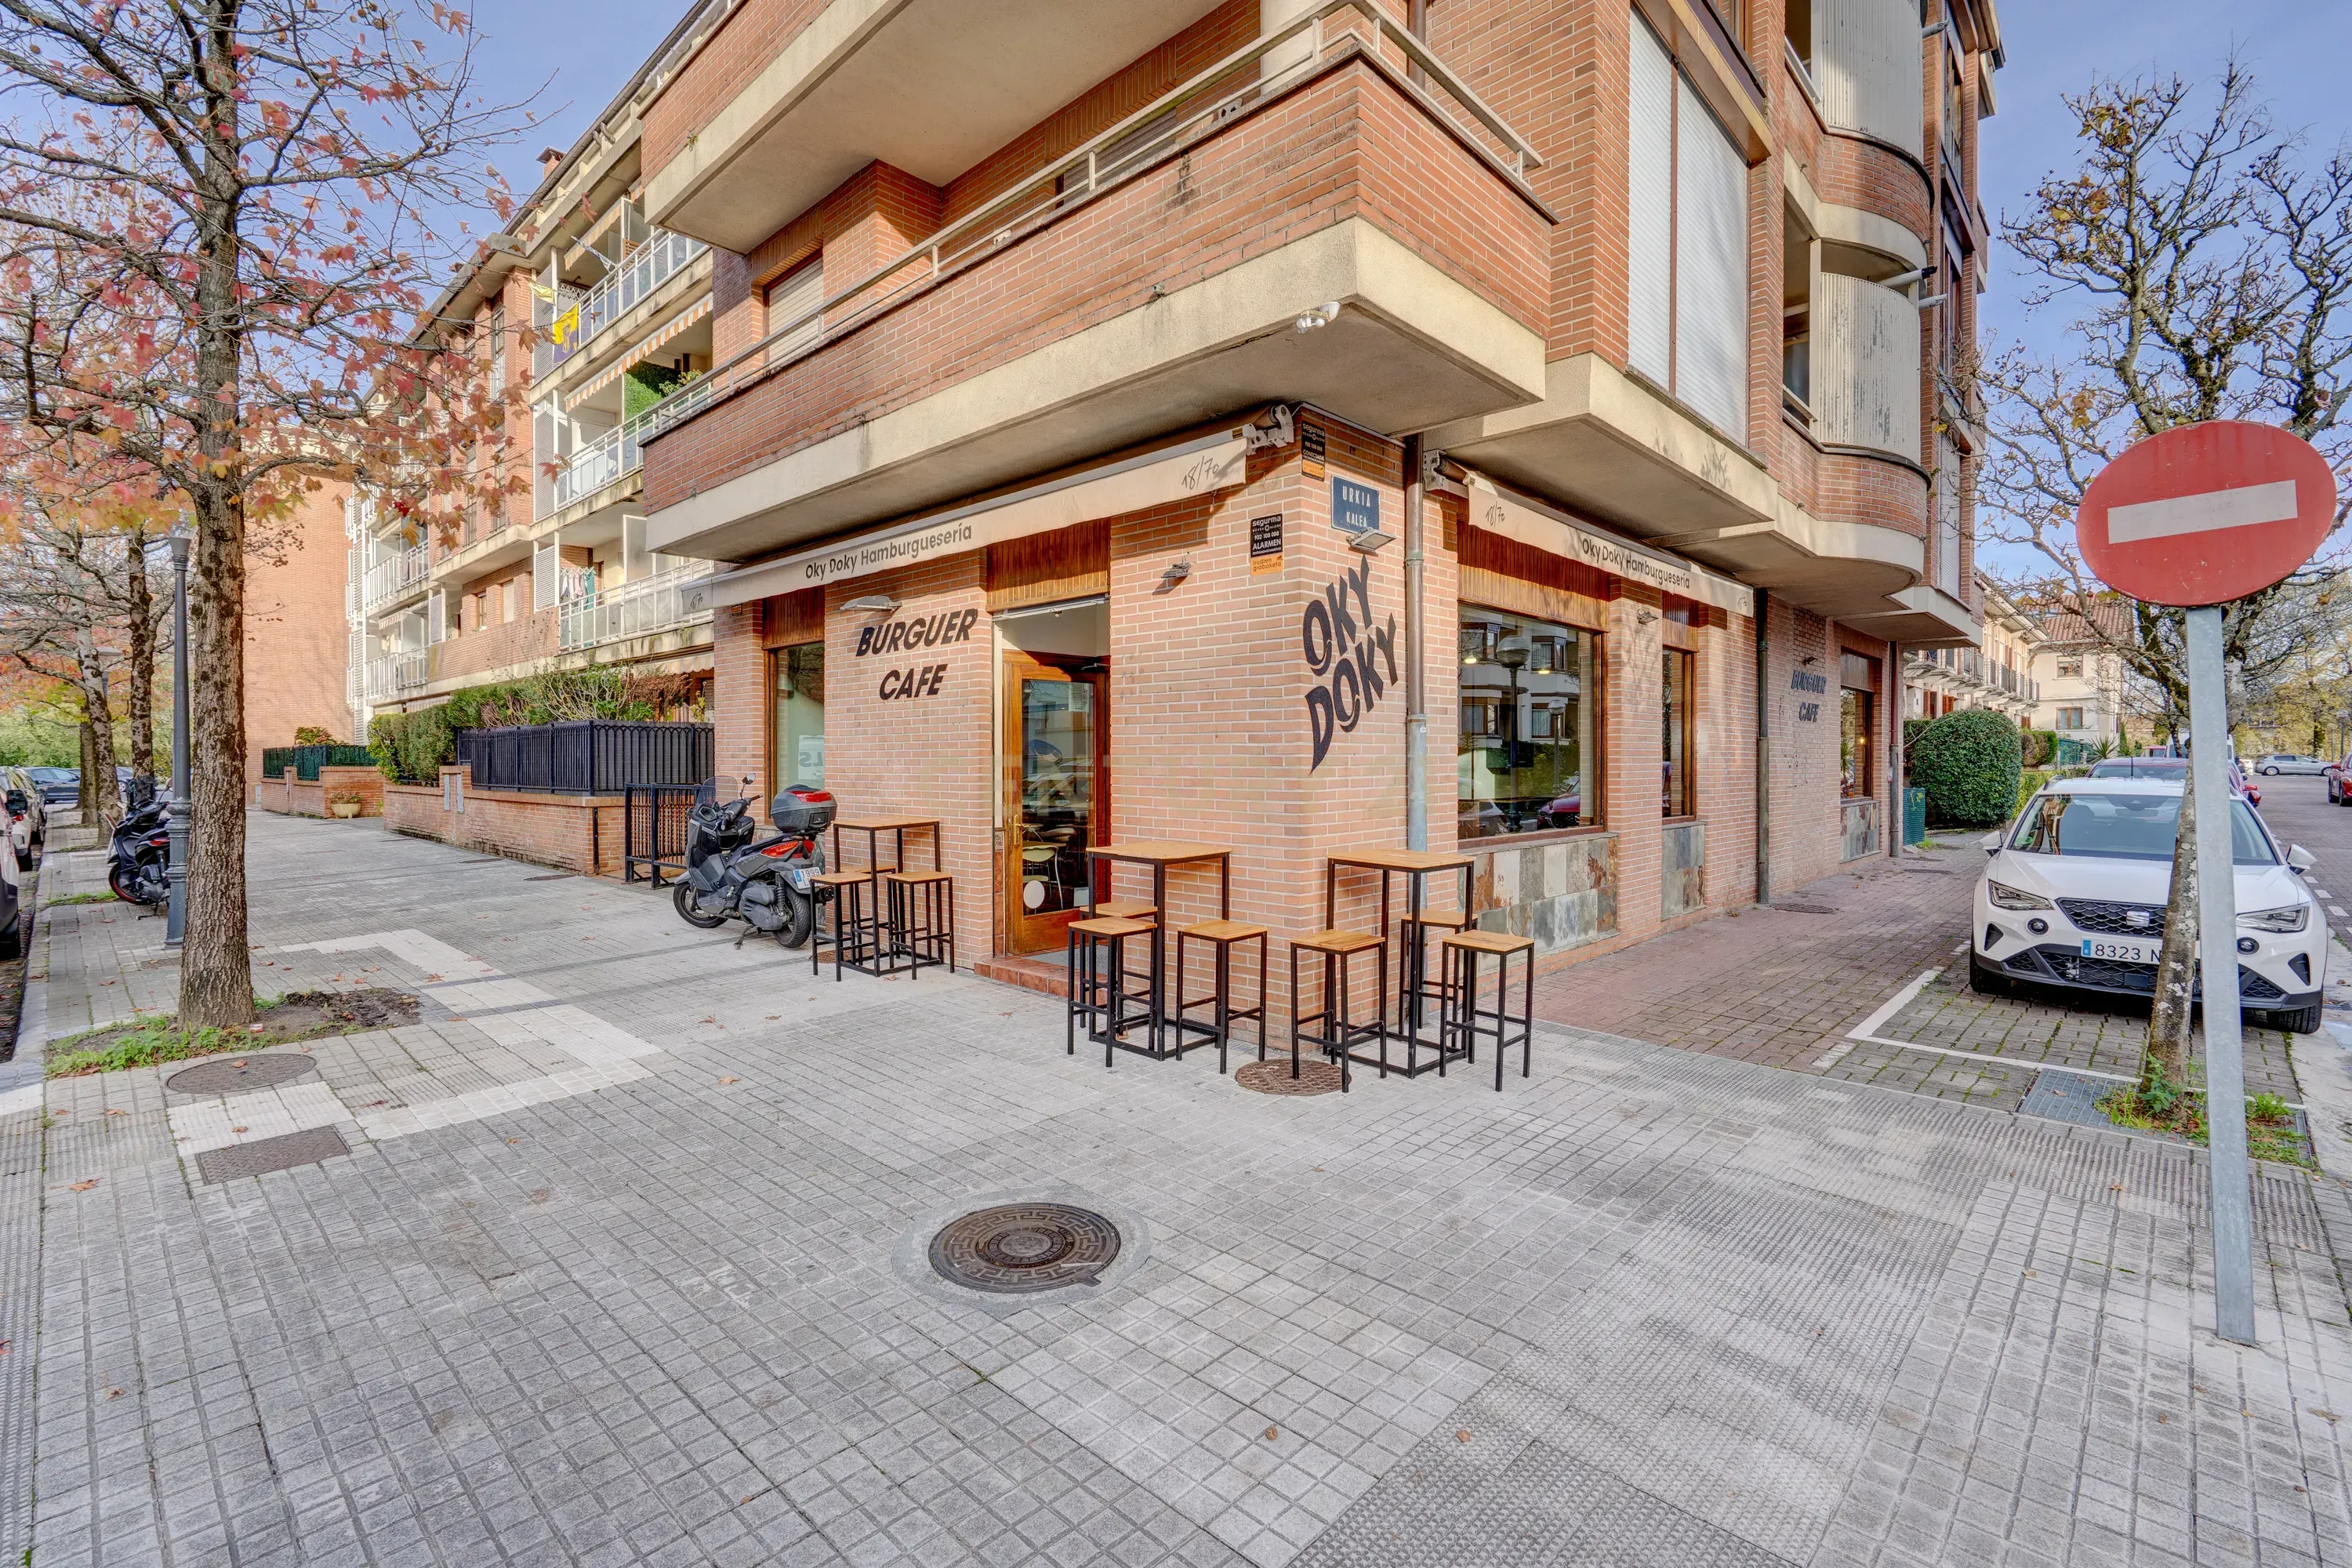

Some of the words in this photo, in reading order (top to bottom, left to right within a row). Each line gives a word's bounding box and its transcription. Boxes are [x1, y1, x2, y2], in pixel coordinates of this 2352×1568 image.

[1302, 423, 1325, 437] segurma
[1343, 485, 1370, 507] URKIA
[1252, 516, 1281, 527] segurma
[1346, 511, 1367, 528] KALEA
[805, 561, 826, 581] Oky
[829, 554, 858, 574] Doky
[861, 523, 972, 565] Hamburguesería
[1253, 539, 1281, 550] ALARMEN
[1253, 562, 1282, 572] grabaketa
[1582, 538, 1600, 563] Oky
[1602, 546, 1624, 572] Doky
[1626, 554, 1690, 589] Hamburguesería
[1303, 554, 1373, 677] OKY
[855, 608, 978, 657] BURGUER
[880, 664, 948, 700] CAFE
[1791, 670, 1827, 695] BURGUER
[1305, 612, 1399, 775] DOKY
[1799, 702, 1819, 722] CAFE
[801, 869, 820, 878] 1999
[2095, 944, 2141, 960] 8323
